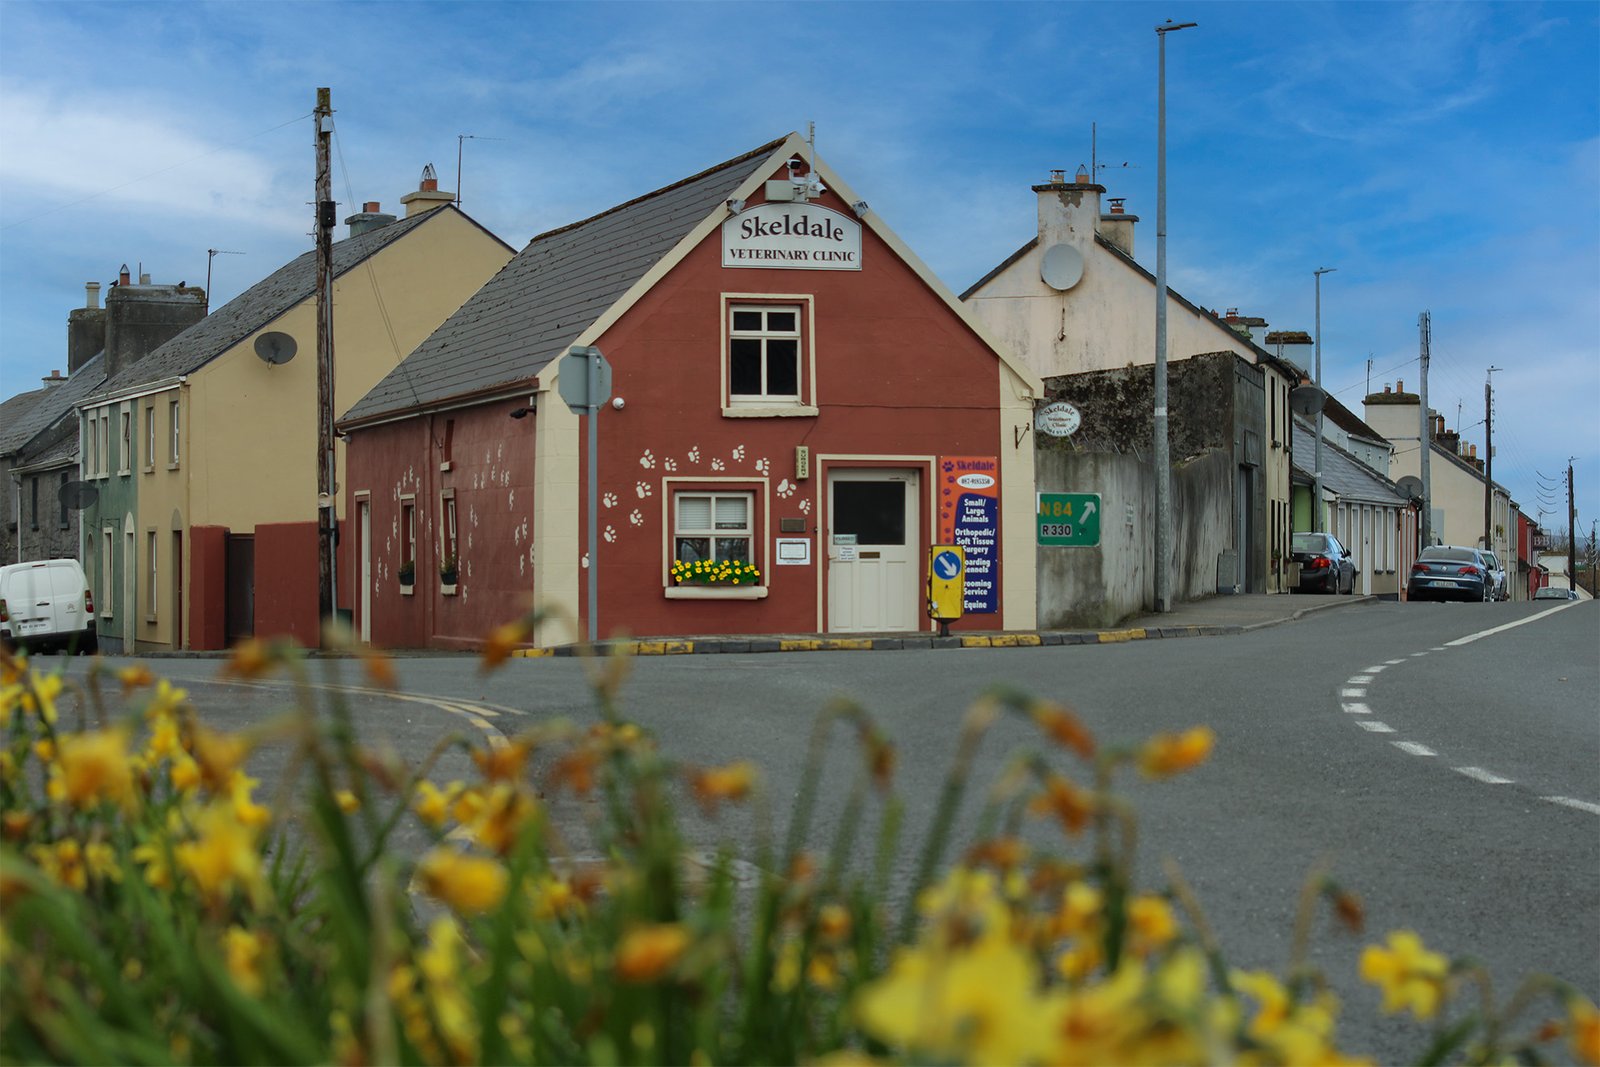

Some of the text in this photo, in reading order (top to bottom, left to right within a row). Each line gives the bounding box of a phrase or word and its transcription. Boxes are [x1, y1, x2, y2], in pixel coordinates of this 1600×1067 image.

[741, 214, 844, 242] Skeldale
[730, 248, 855, 262] VETERINARY CLINIC
[1044, 403, 1075, 415] Skeldale
[957, 461, 994, 471] Skeldale
[964, 498, 986, 507] Small/
[966, 507, 985, 516] Large
[962, 515, 989, 523] Animals
[955, 528, 995, 537] Orthopedic/
[956, 537, 994, 545] Soft Tissue
[962, 545, 989, 554] Surgery
[965, 558, 991, 567] oarding
[964, 579, 992, 589] rooming
[964, 600, 987, 610] Equine
